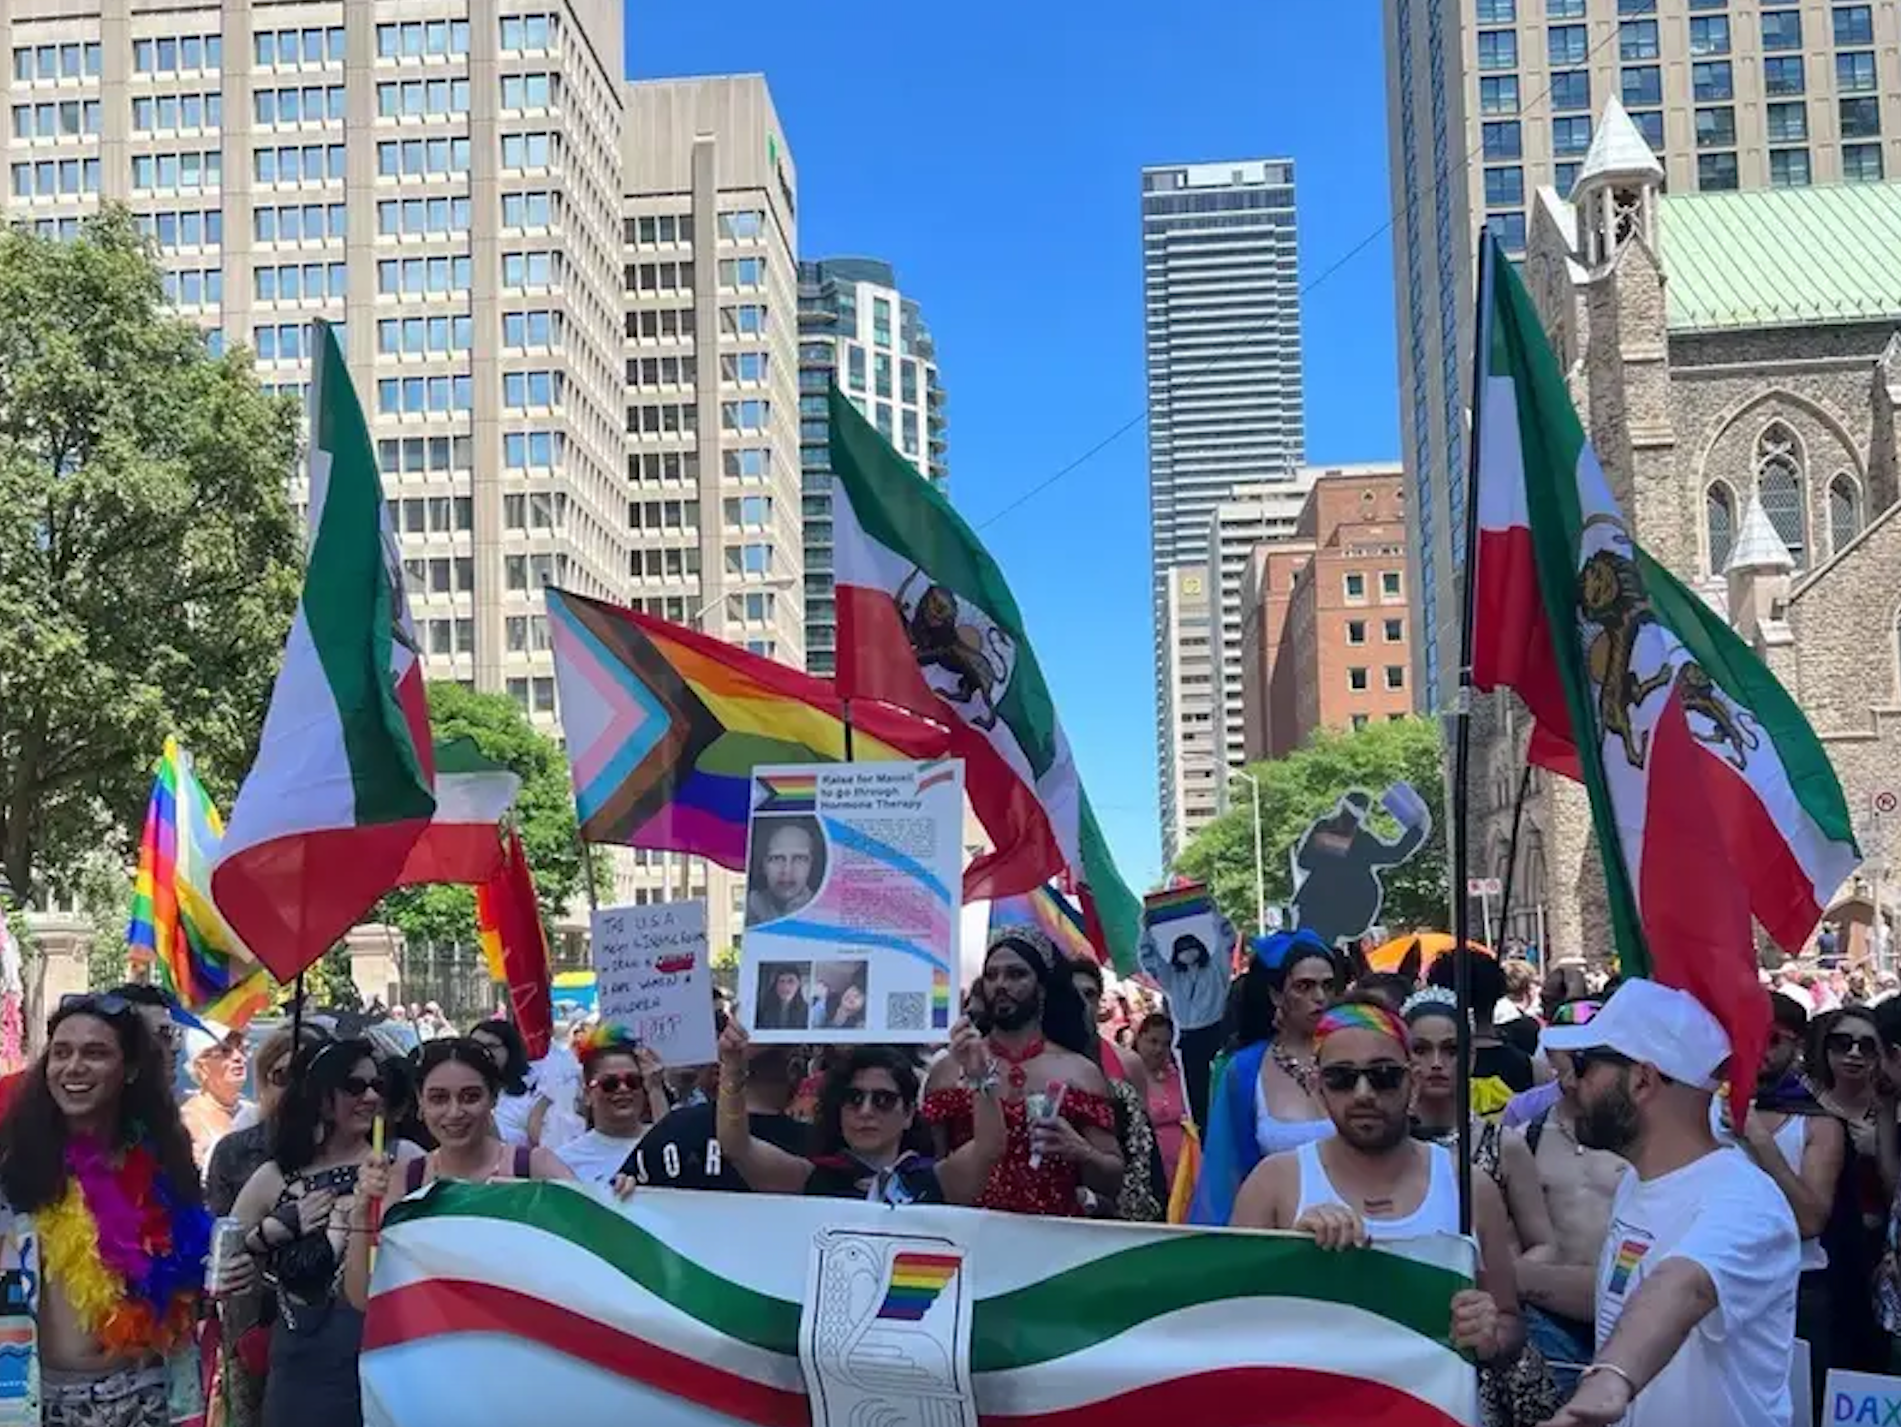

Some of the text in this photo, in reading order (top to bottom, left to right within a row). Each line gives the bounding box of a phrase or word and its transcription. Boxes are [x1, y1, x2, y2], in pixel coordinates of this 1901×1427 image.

[822, 774, 854, 784] Raise
[856, 773, 873, 783] for
[821, 786, 900, 799] to go through
[821, 799, 922, 811] Hormone Therapy
